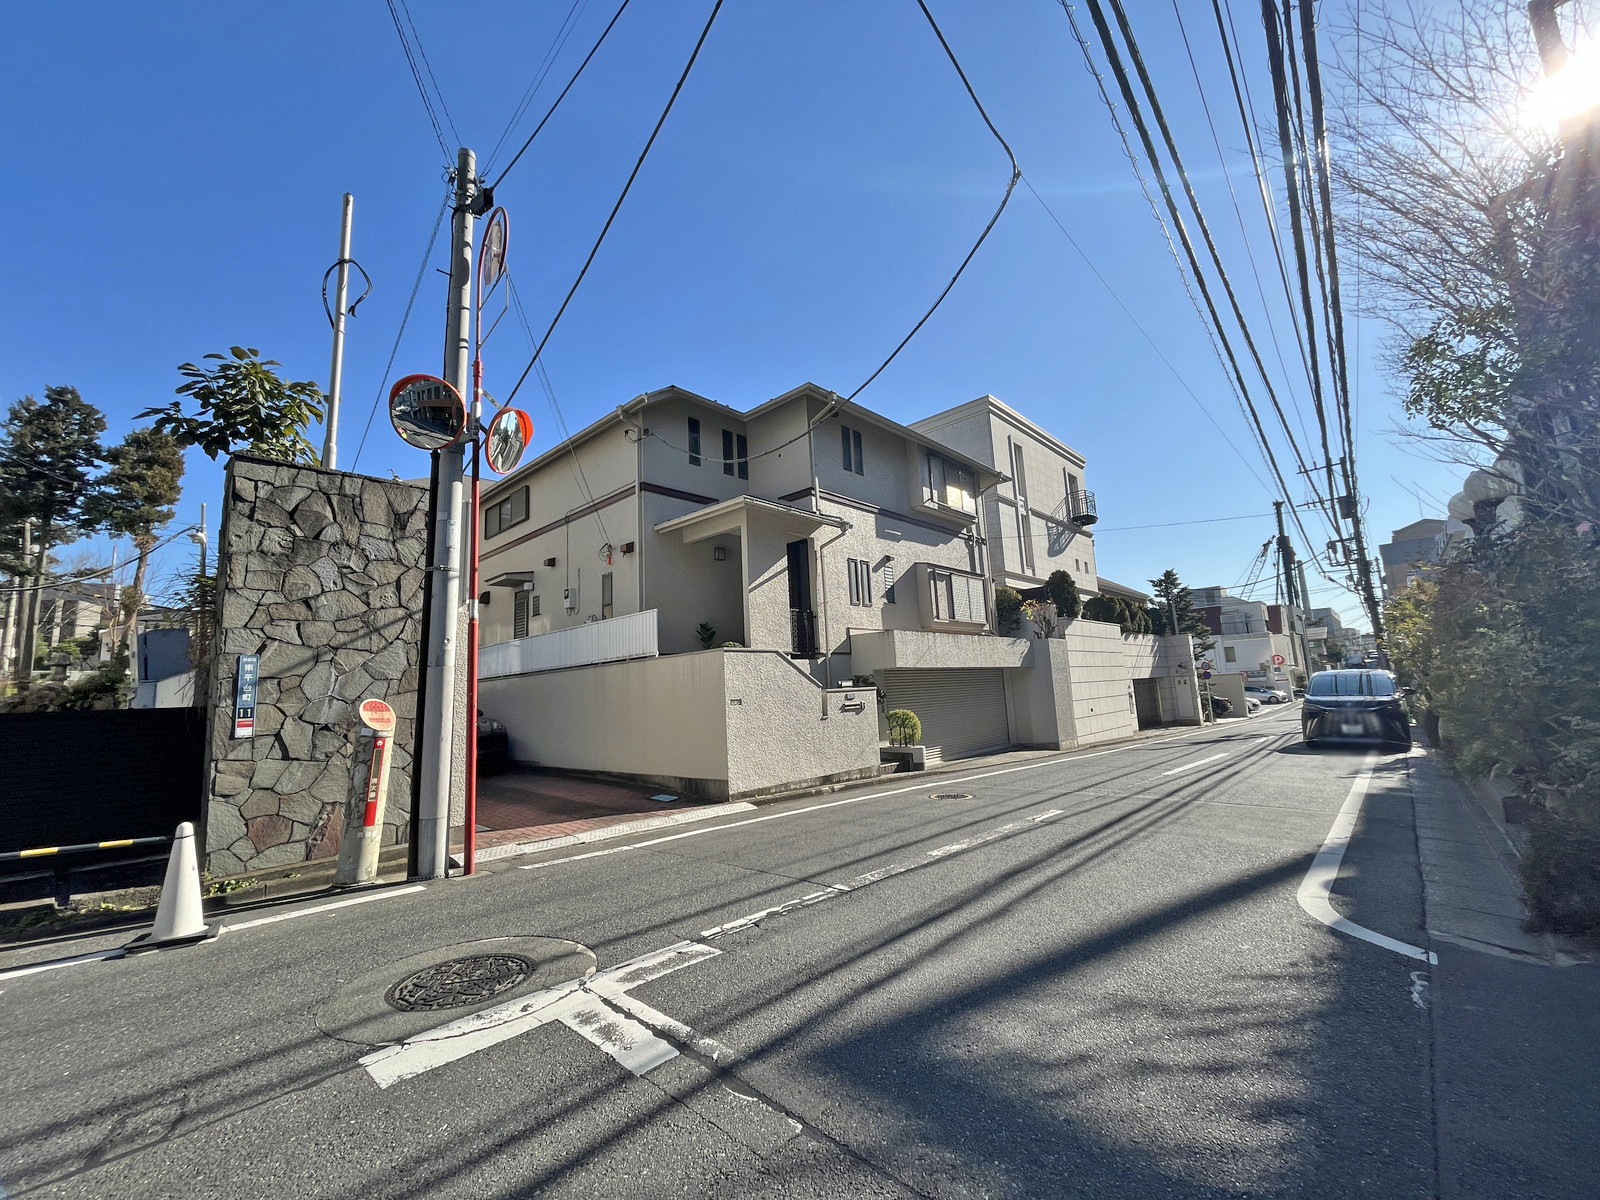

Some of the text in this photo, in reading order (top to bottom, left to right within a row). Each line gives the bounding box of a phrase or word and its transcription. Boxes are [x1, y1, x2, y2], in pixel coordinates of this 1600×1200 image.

[1274, 655, 1282, 666] P
[242, 664, 254, 701] 南平台町
[239, 708, 251, 718] 11
